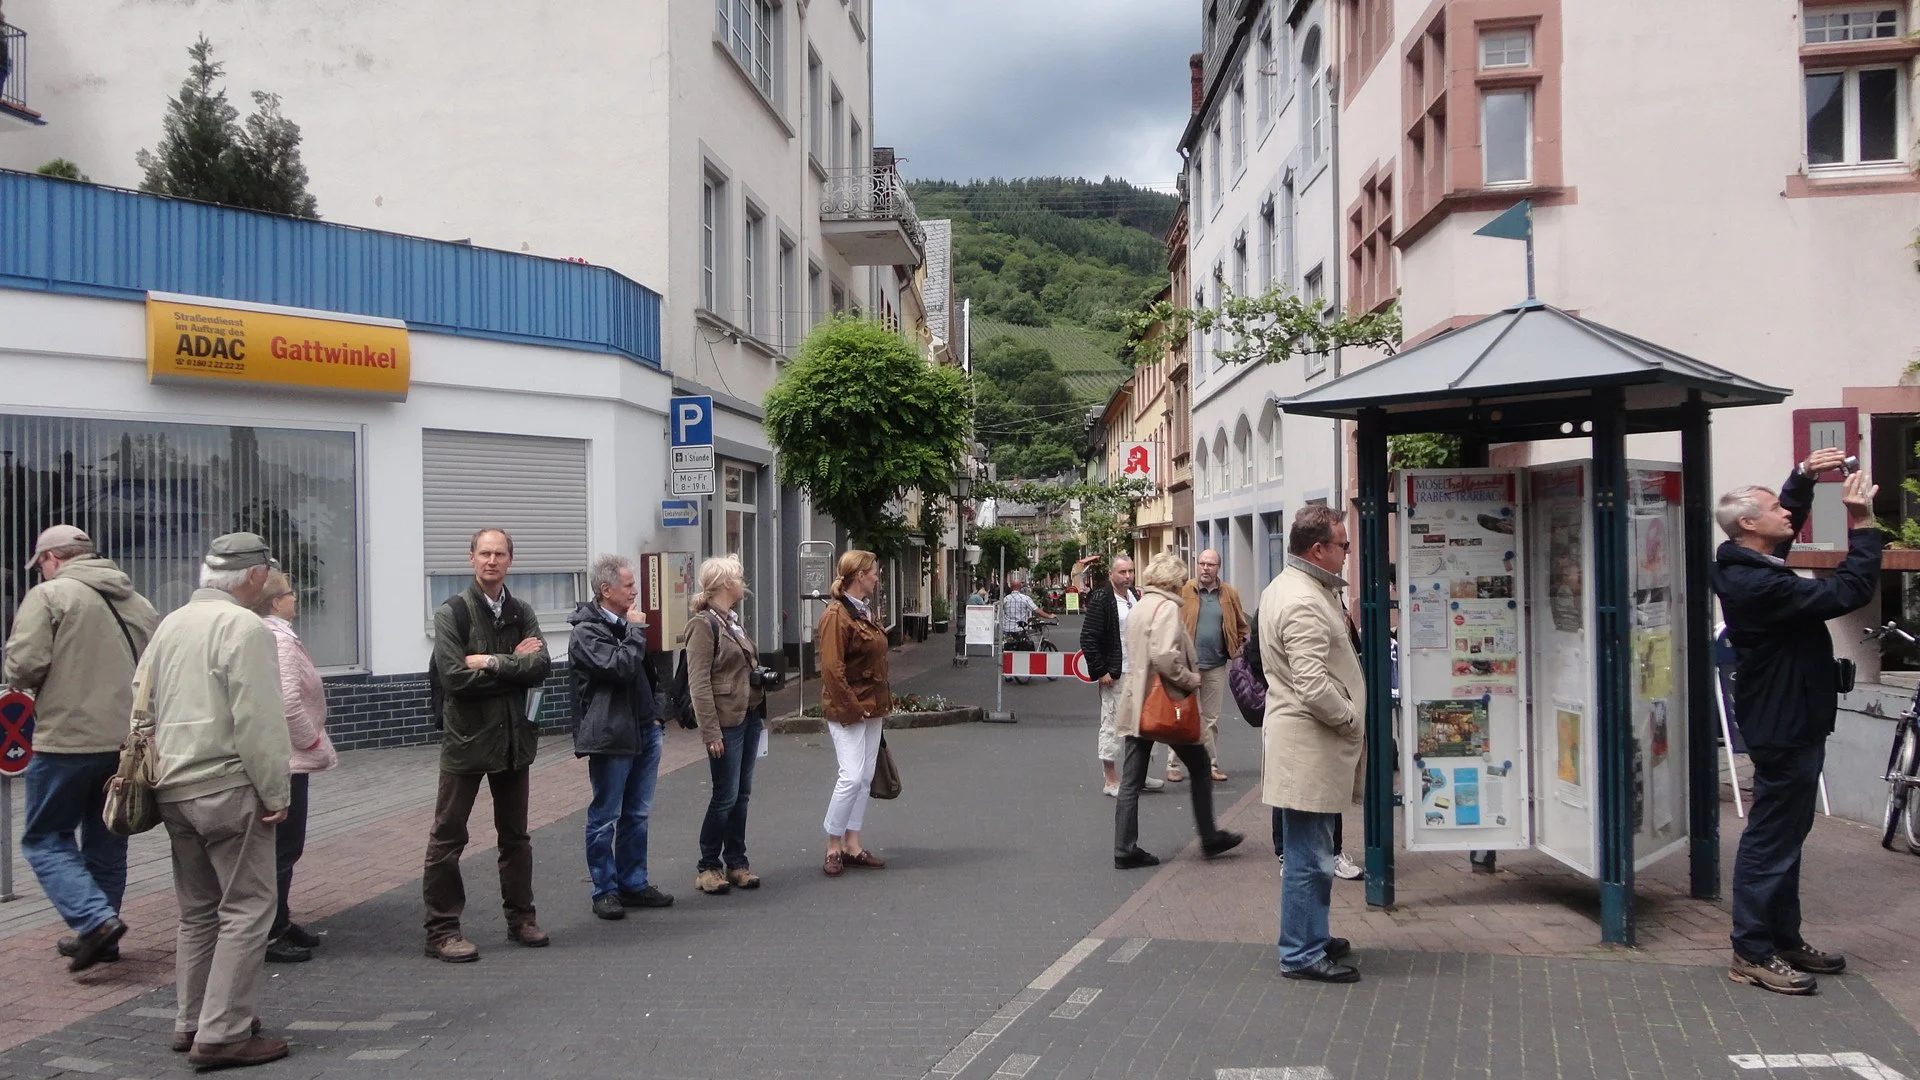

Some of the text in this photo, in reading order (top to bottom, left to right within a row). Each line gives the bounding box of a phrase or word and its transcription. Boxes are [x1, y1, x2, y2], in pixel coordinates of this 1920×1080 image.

[174, 311, 244, 327] Straßendienst
[176, 322, 245, 337] im Auftrag des
[176, 334, 246, 361] ADAC
[270, 335, 396, 370] Gattwinkel
[679, 403, 704, 443] P
[689, 454, 710, 463] Stunde
